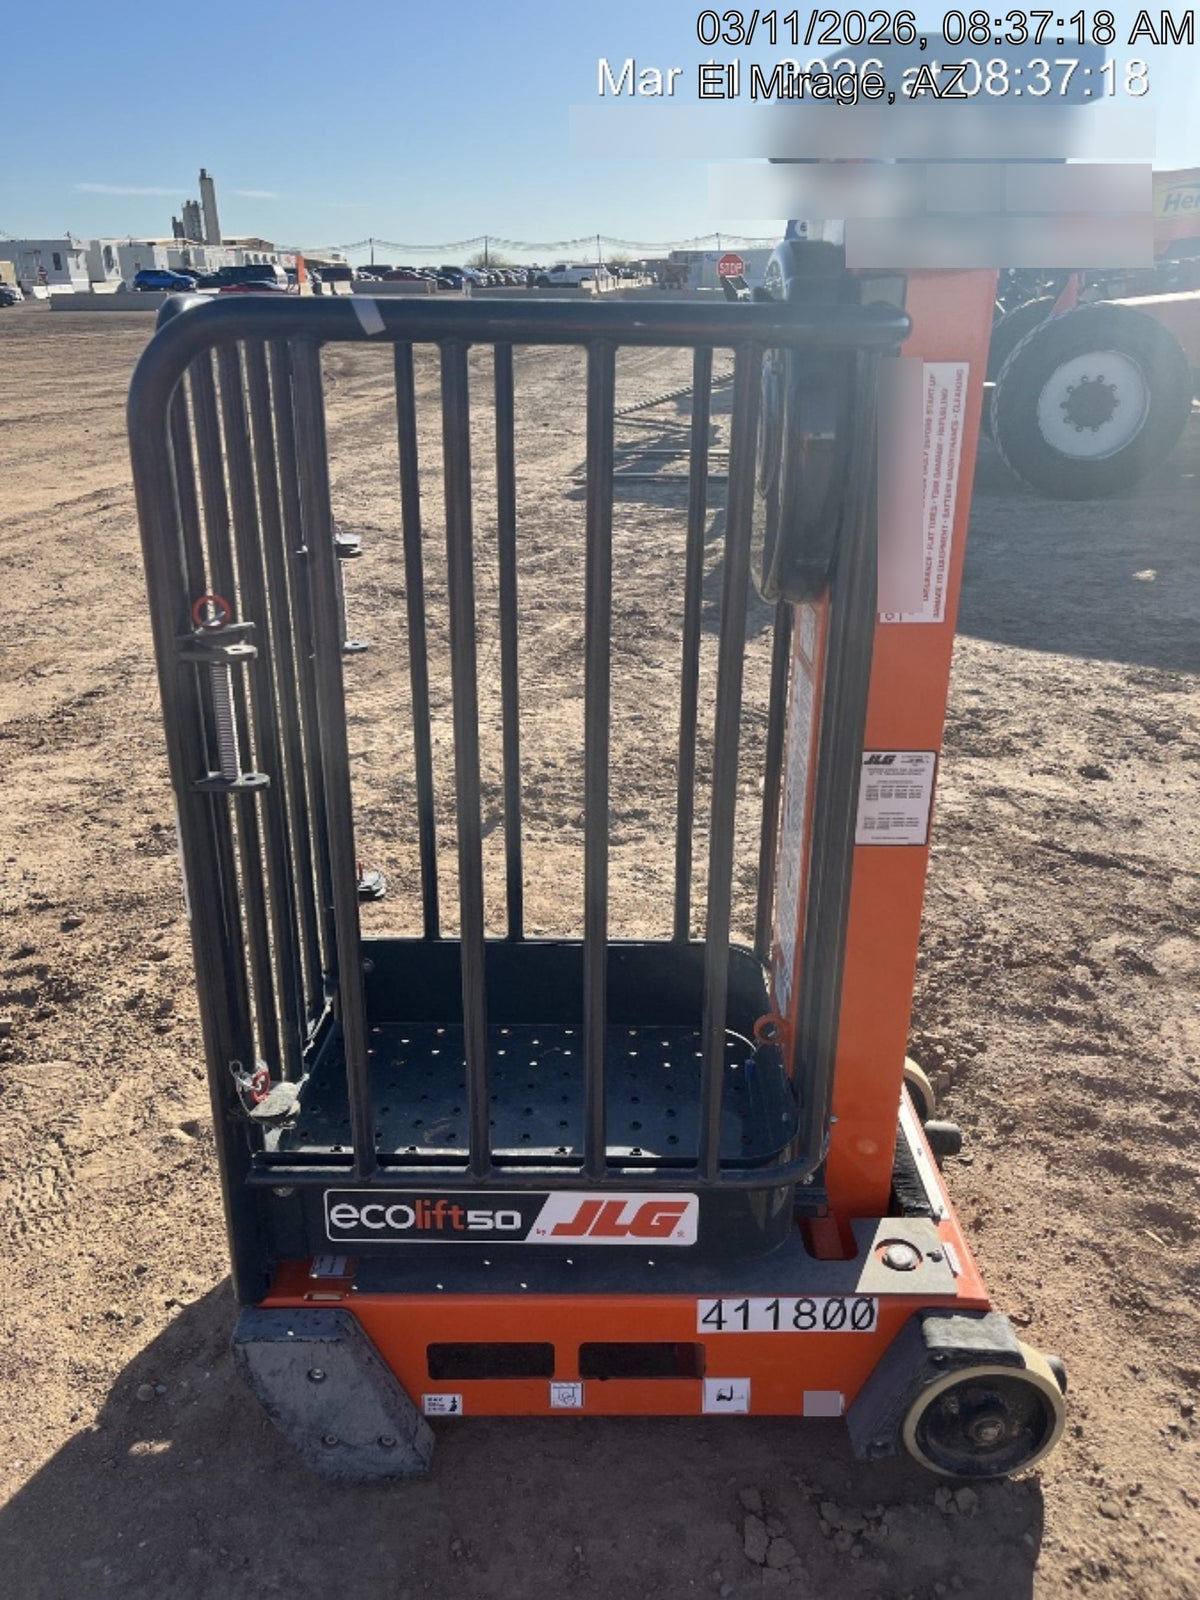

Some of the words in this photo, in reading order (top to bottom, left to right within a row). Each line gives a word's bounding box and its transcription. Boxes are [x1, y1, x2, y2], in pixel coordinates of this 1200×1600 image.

[719, 262, 742, 275] STOP
[551, 1200, 690, 1237] JLG
[702, 1299, 876, 1331] 411800
